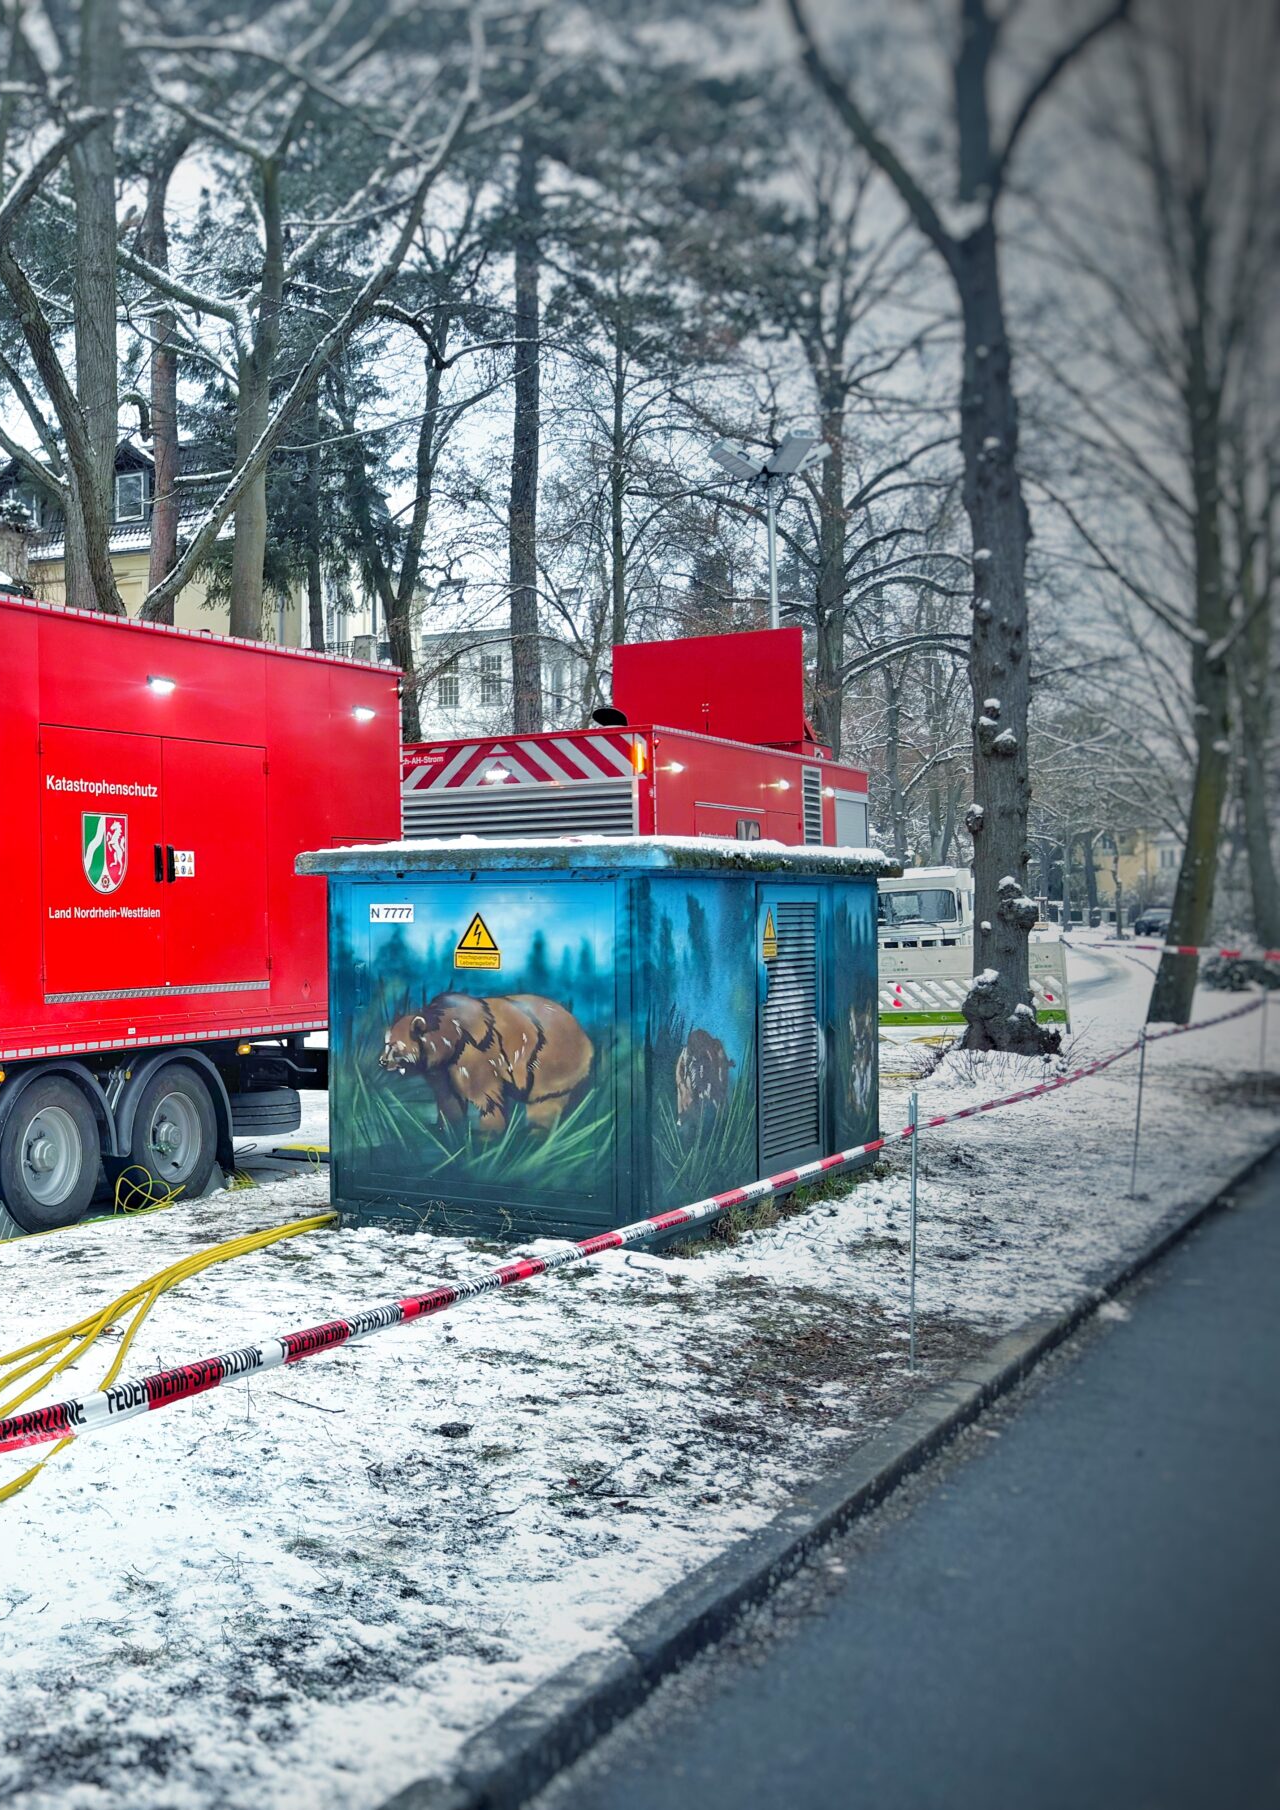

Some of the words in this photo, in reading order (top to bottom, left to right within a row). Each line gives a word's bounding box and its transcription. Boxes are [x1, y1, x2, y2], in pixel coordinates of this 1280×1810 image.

[46, 775, 158, 797] Katastrophenschutz
[49, 907, 71, 919] Land
[74, 907, 160, 919] Nordrhein-Westfalen
[371, 907, 380, 919] N
[383, 907, 412, 919] 7777
[103, 1346, 264, 1414] FEUERWEHR-SPERRZONE
